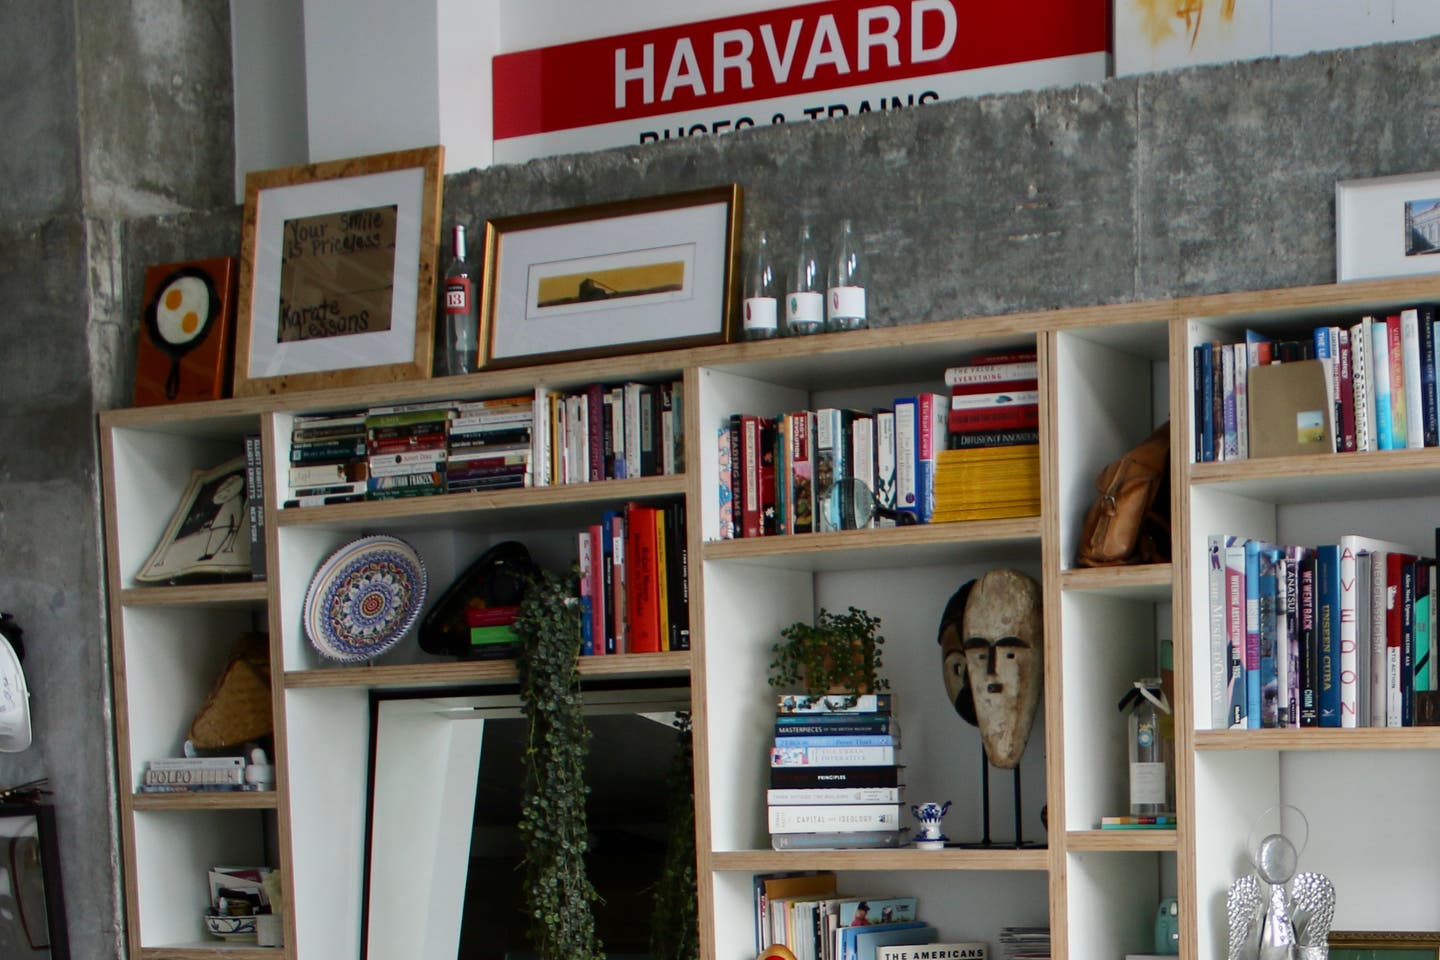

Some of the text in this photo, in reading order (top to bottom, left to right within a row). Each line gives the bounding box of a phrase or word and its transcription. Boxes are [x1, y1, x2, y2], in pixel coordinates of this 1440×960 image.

[615, 0, 958, 109] HARVARD
[291, 223, 328, 244] Your
[313, 232, 381, 257] Priceless
[282, 299, 340, 331] Karate
[1318, 331, 1326, 347] THE
[953, 373, 1002, 383] EVERYTHING
[1341, 349, 1349, 379] Strategy
[921, 400, 930, 457] Michael Lewis
[410, 473, 434, 487] FRANZEN
[731, 431, 741, 516] LEADING TEAMS
[1287, 570, 1296, 613] ANATSUI
[1302, 570, 1312, 630] WE WENT BACK
[1373, 560, 1383, 654] NEOCLASSICISM
[1231, 575, 1240, 647] INVENTING ABSTRACTION
[1322, 604, 1331, 691] UNSEEN CUBA
[1340, 547, 1356, 716] AVEDON
[1303, 689, 1312, 708] CHIM
[150, 769, 192, 783] POLPO
[885, 948, 984, 960] THE AMERICANS
